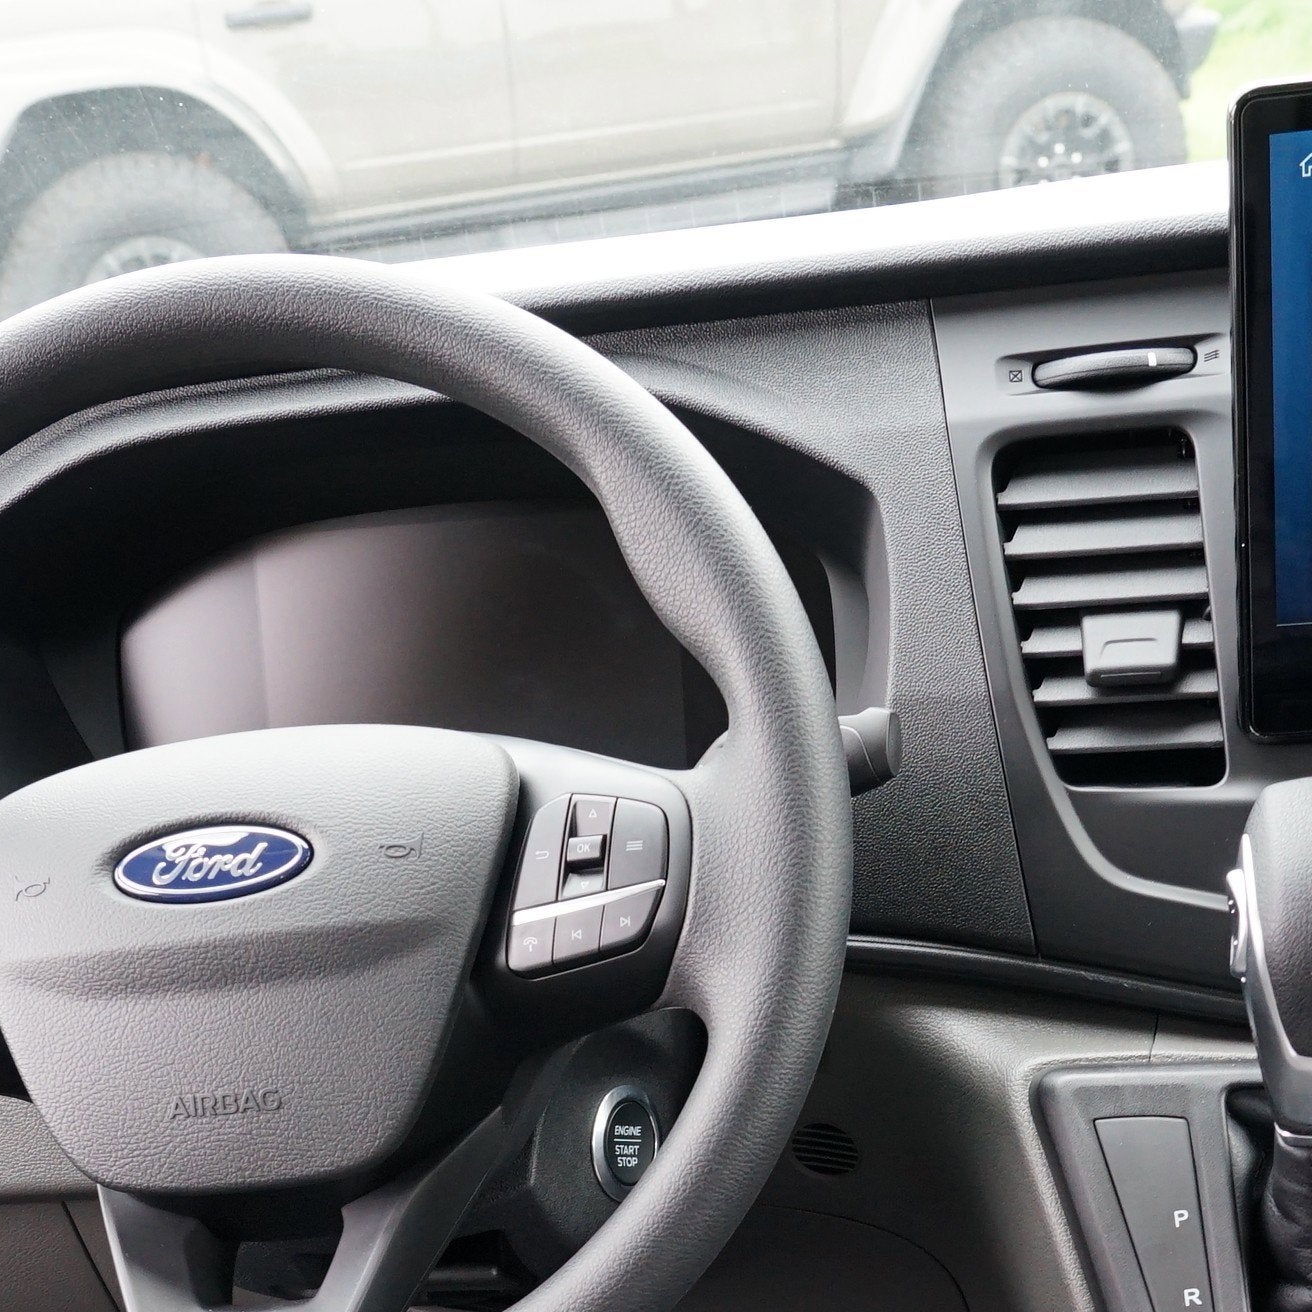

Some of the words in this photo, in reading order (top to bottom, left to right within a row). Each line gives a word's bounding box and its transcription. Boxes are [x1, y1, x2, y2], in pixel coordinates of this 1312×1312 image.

[576, 842, 591, 853] OK
[152, 841, 269, 886] Ford
[169, 1087, 283, 1120] AIRBAG
[614, 1125, 642, 1136] ENGINE
[615, 1144, 640, 1155] START
[617, 1156, 638, 1167] STOP
[1173, 1209, 1189, 1228] P
